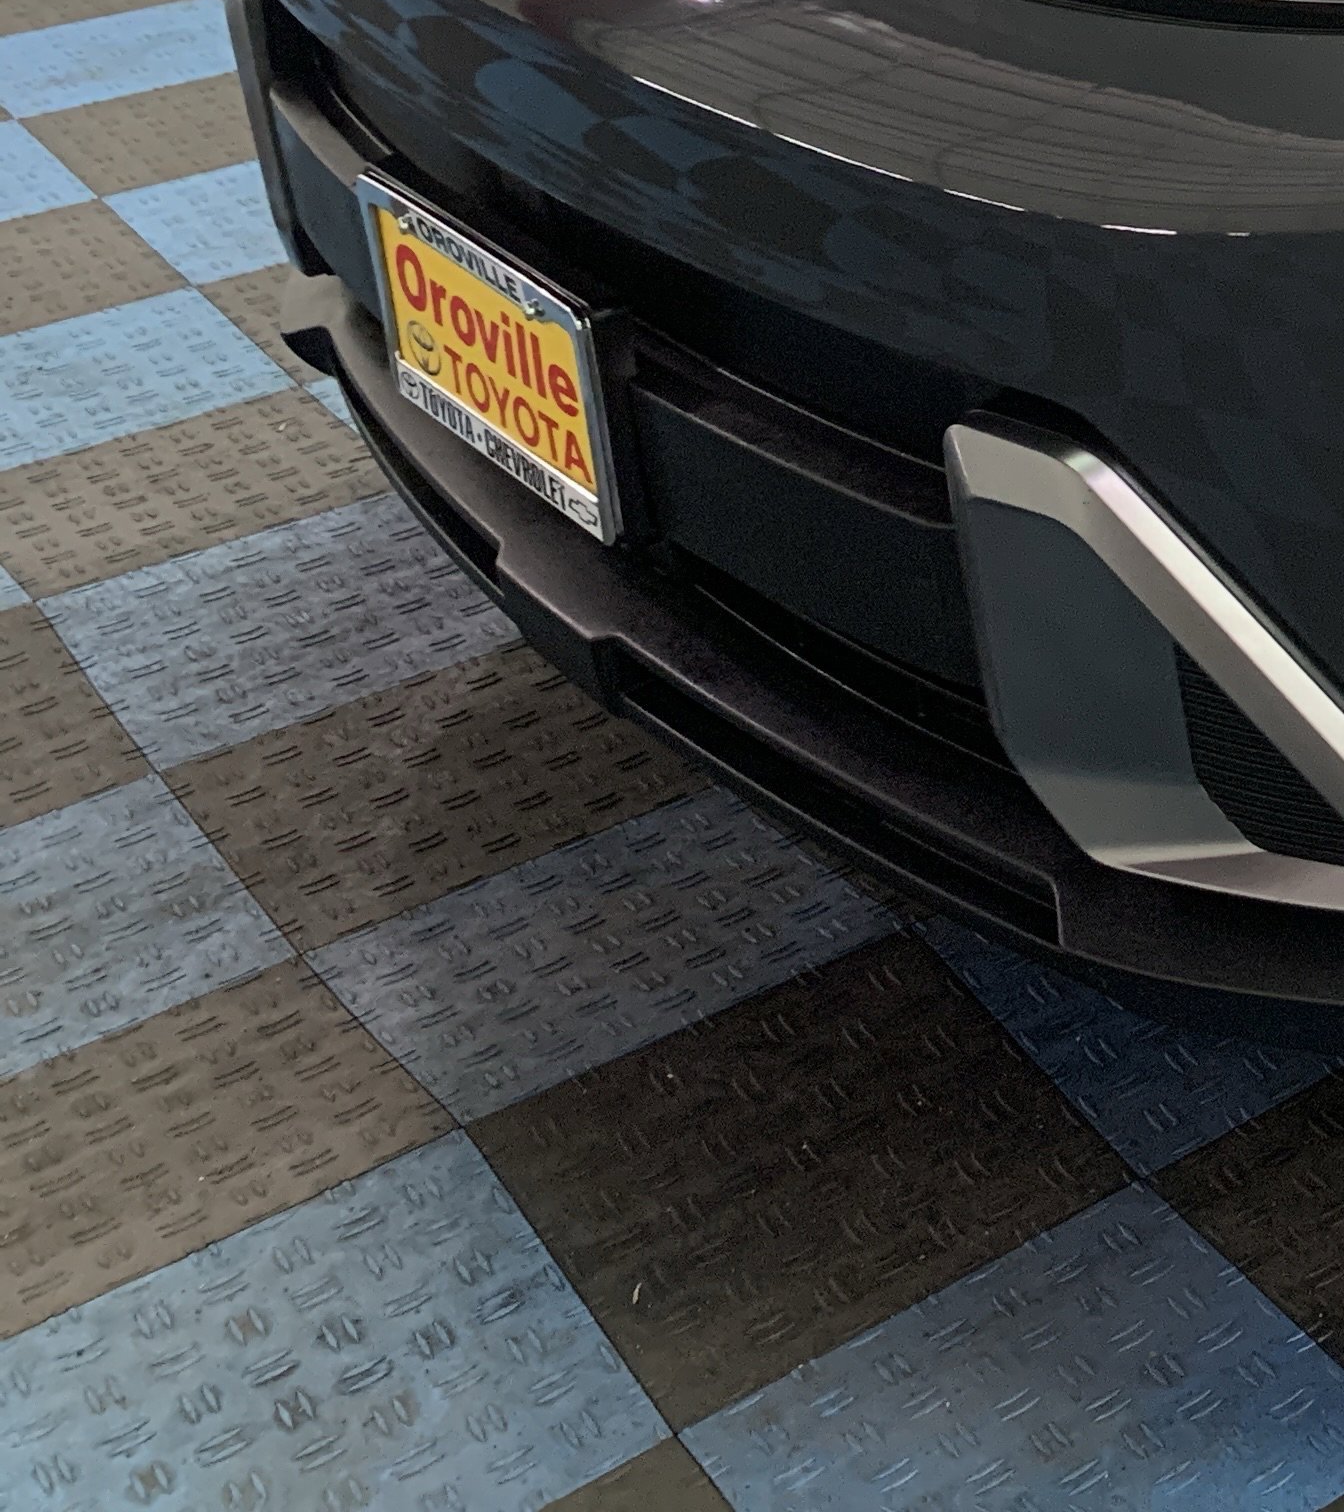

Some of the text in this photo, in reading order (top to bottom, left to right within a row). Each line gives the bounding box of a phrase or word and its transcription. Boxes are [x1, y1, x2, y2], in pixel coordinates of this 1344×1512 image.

[416, 217, 521, 304] OROVILLE
[396, 244, 579, 418] Oroville
[421, 382, 567, 511] TOYOTA CHEVROLET
[444, 344, 593, 486] TOYOTA
